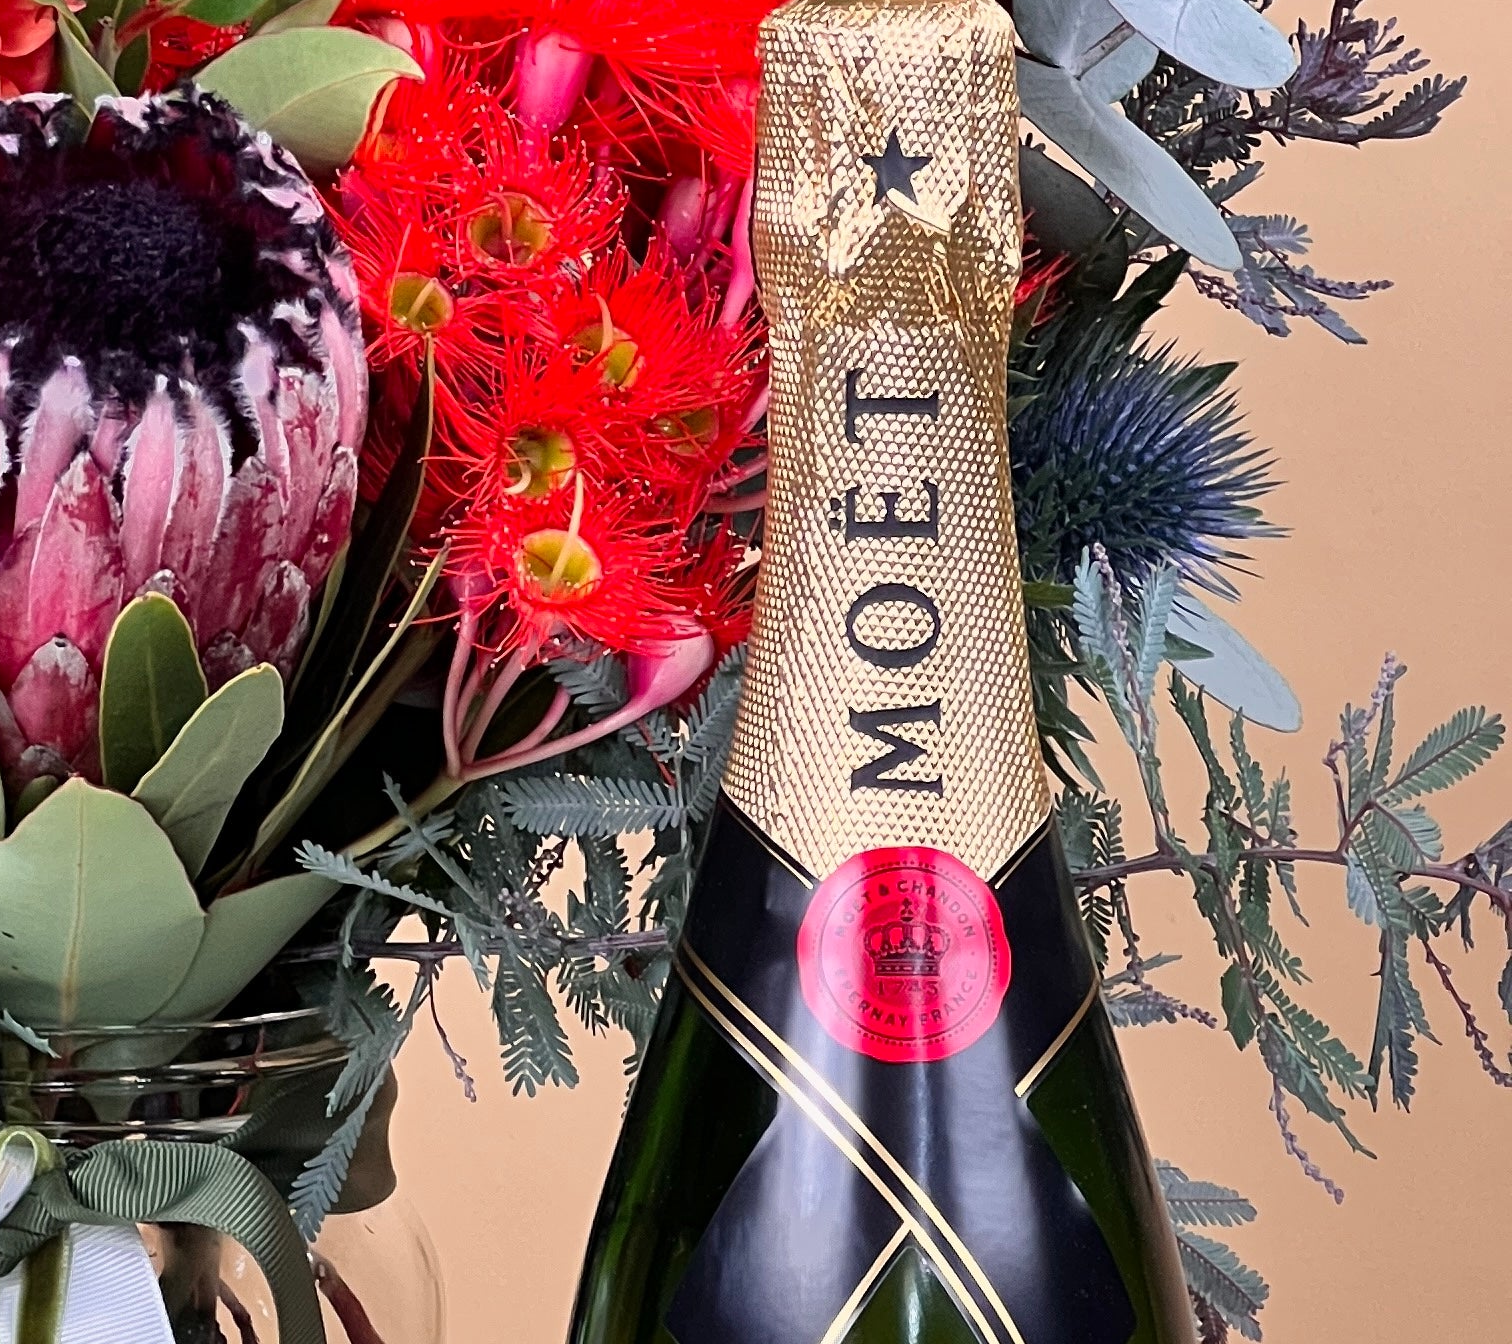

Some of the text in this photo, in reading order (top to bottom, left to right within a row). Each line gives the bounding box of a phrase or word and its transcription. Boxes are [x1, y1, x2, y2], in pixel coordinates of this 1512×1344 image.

[828, 367, 944, 799] MOËT
[896, 879, 977, 939] CHANDON
[918, 969, 978, 1027] FRANCE
